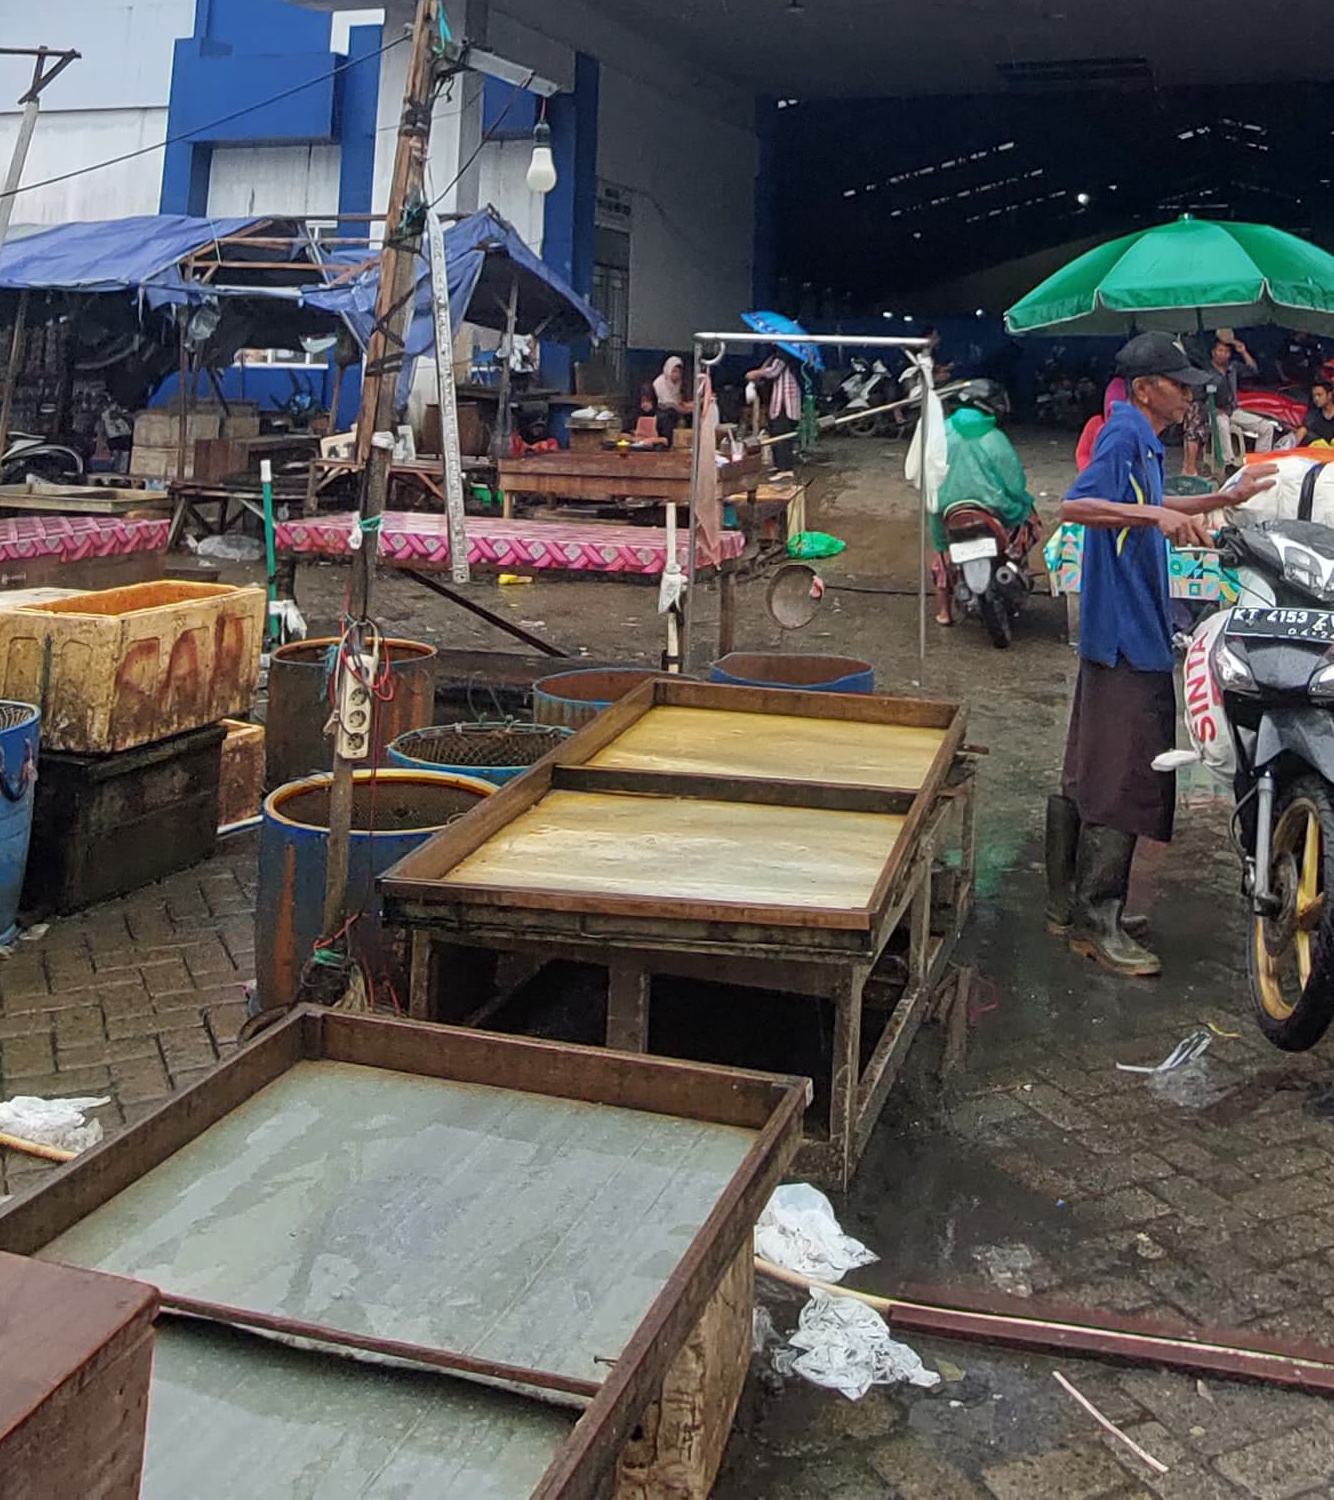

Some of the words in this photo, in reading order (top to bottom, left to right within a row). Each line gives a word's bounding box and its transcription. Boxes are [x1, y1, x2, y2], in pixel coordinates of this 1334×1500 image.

[1233, 608, 1259, 621] KT
[1266, 609, 1309, 624] 4153
[1186, 631, 1217, 742] SINTA
